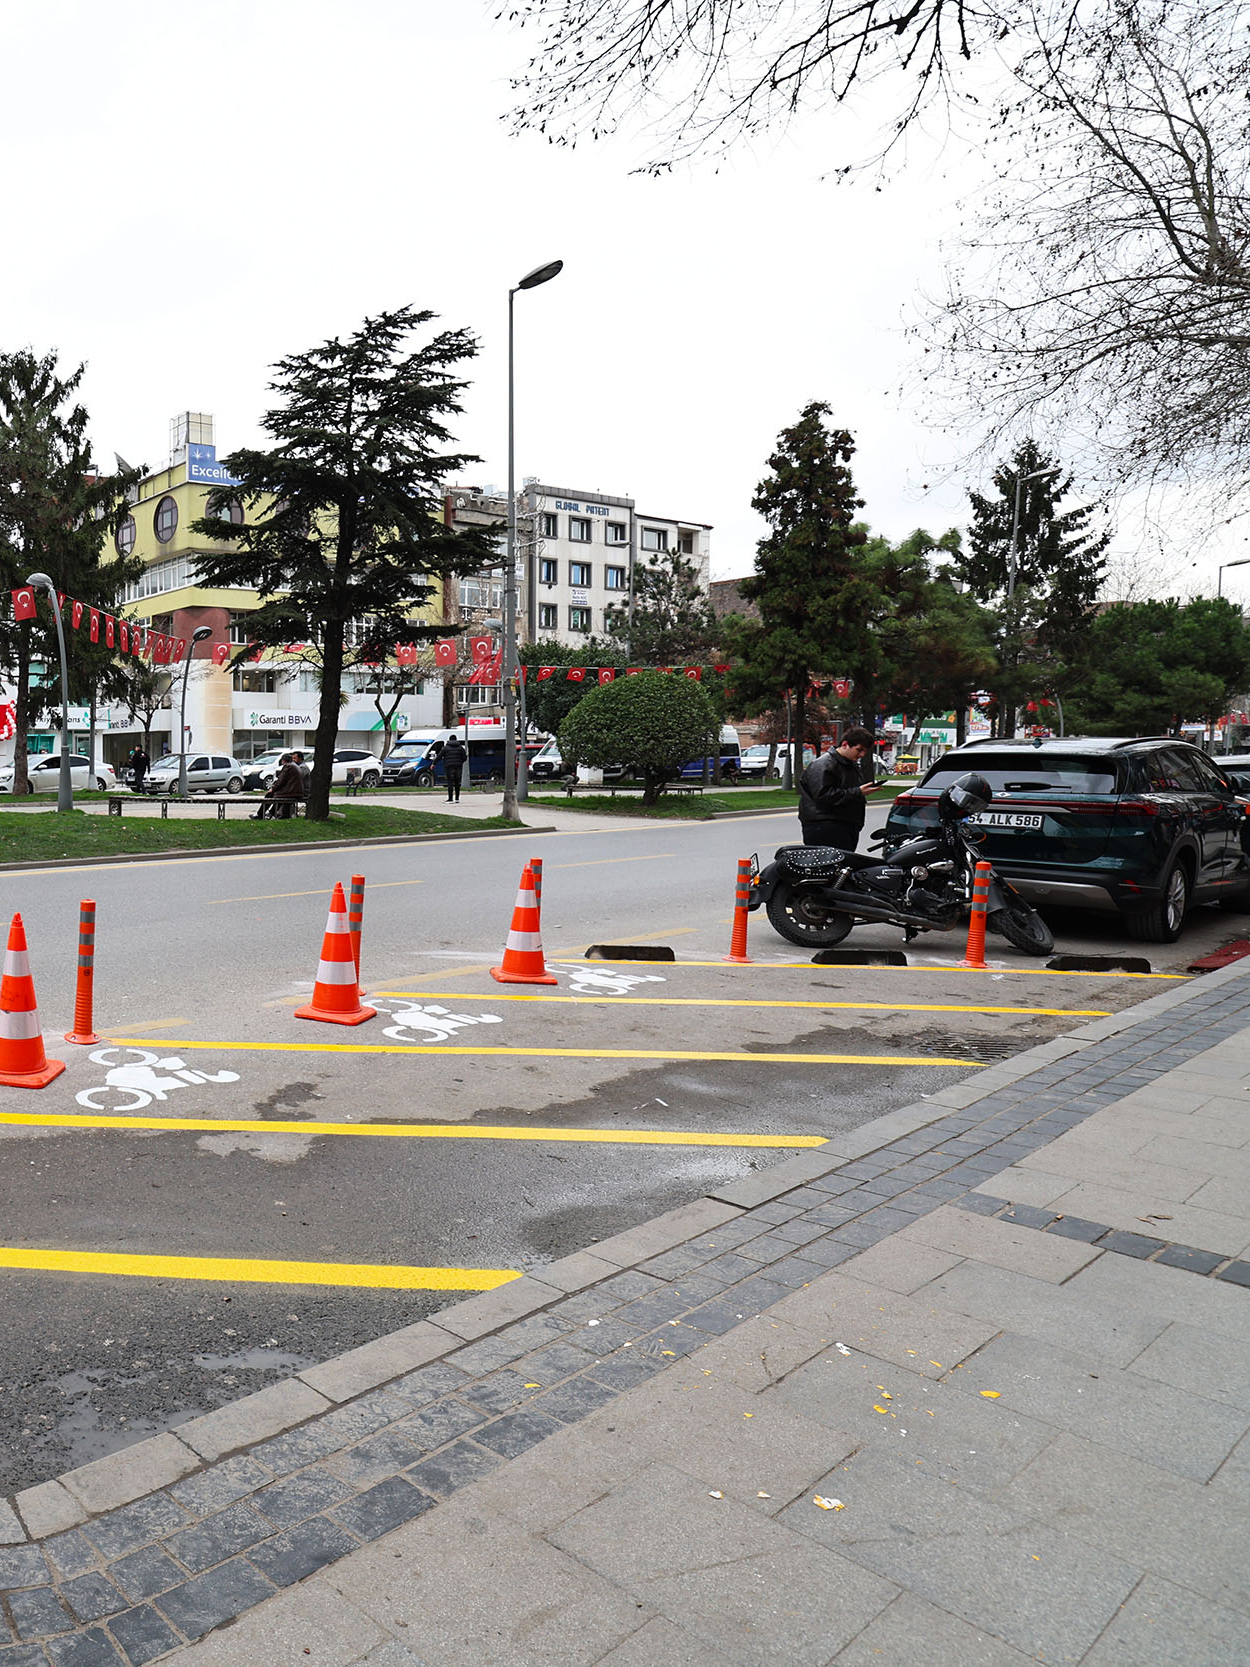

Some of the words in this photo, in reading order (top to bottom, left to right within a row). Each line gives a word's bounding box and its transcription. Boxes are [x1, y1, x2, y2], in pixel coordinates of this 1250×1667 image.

[555, 500, 581, 513] GLOBAL
[585, 504, 610, 517] PATENT
[259, 714, 287, 725] Garanti
[288, 716, 312, 725] BBVA
[989, 814, 1013, 826] ALK
[1015, 815, 1040, 827] 586
